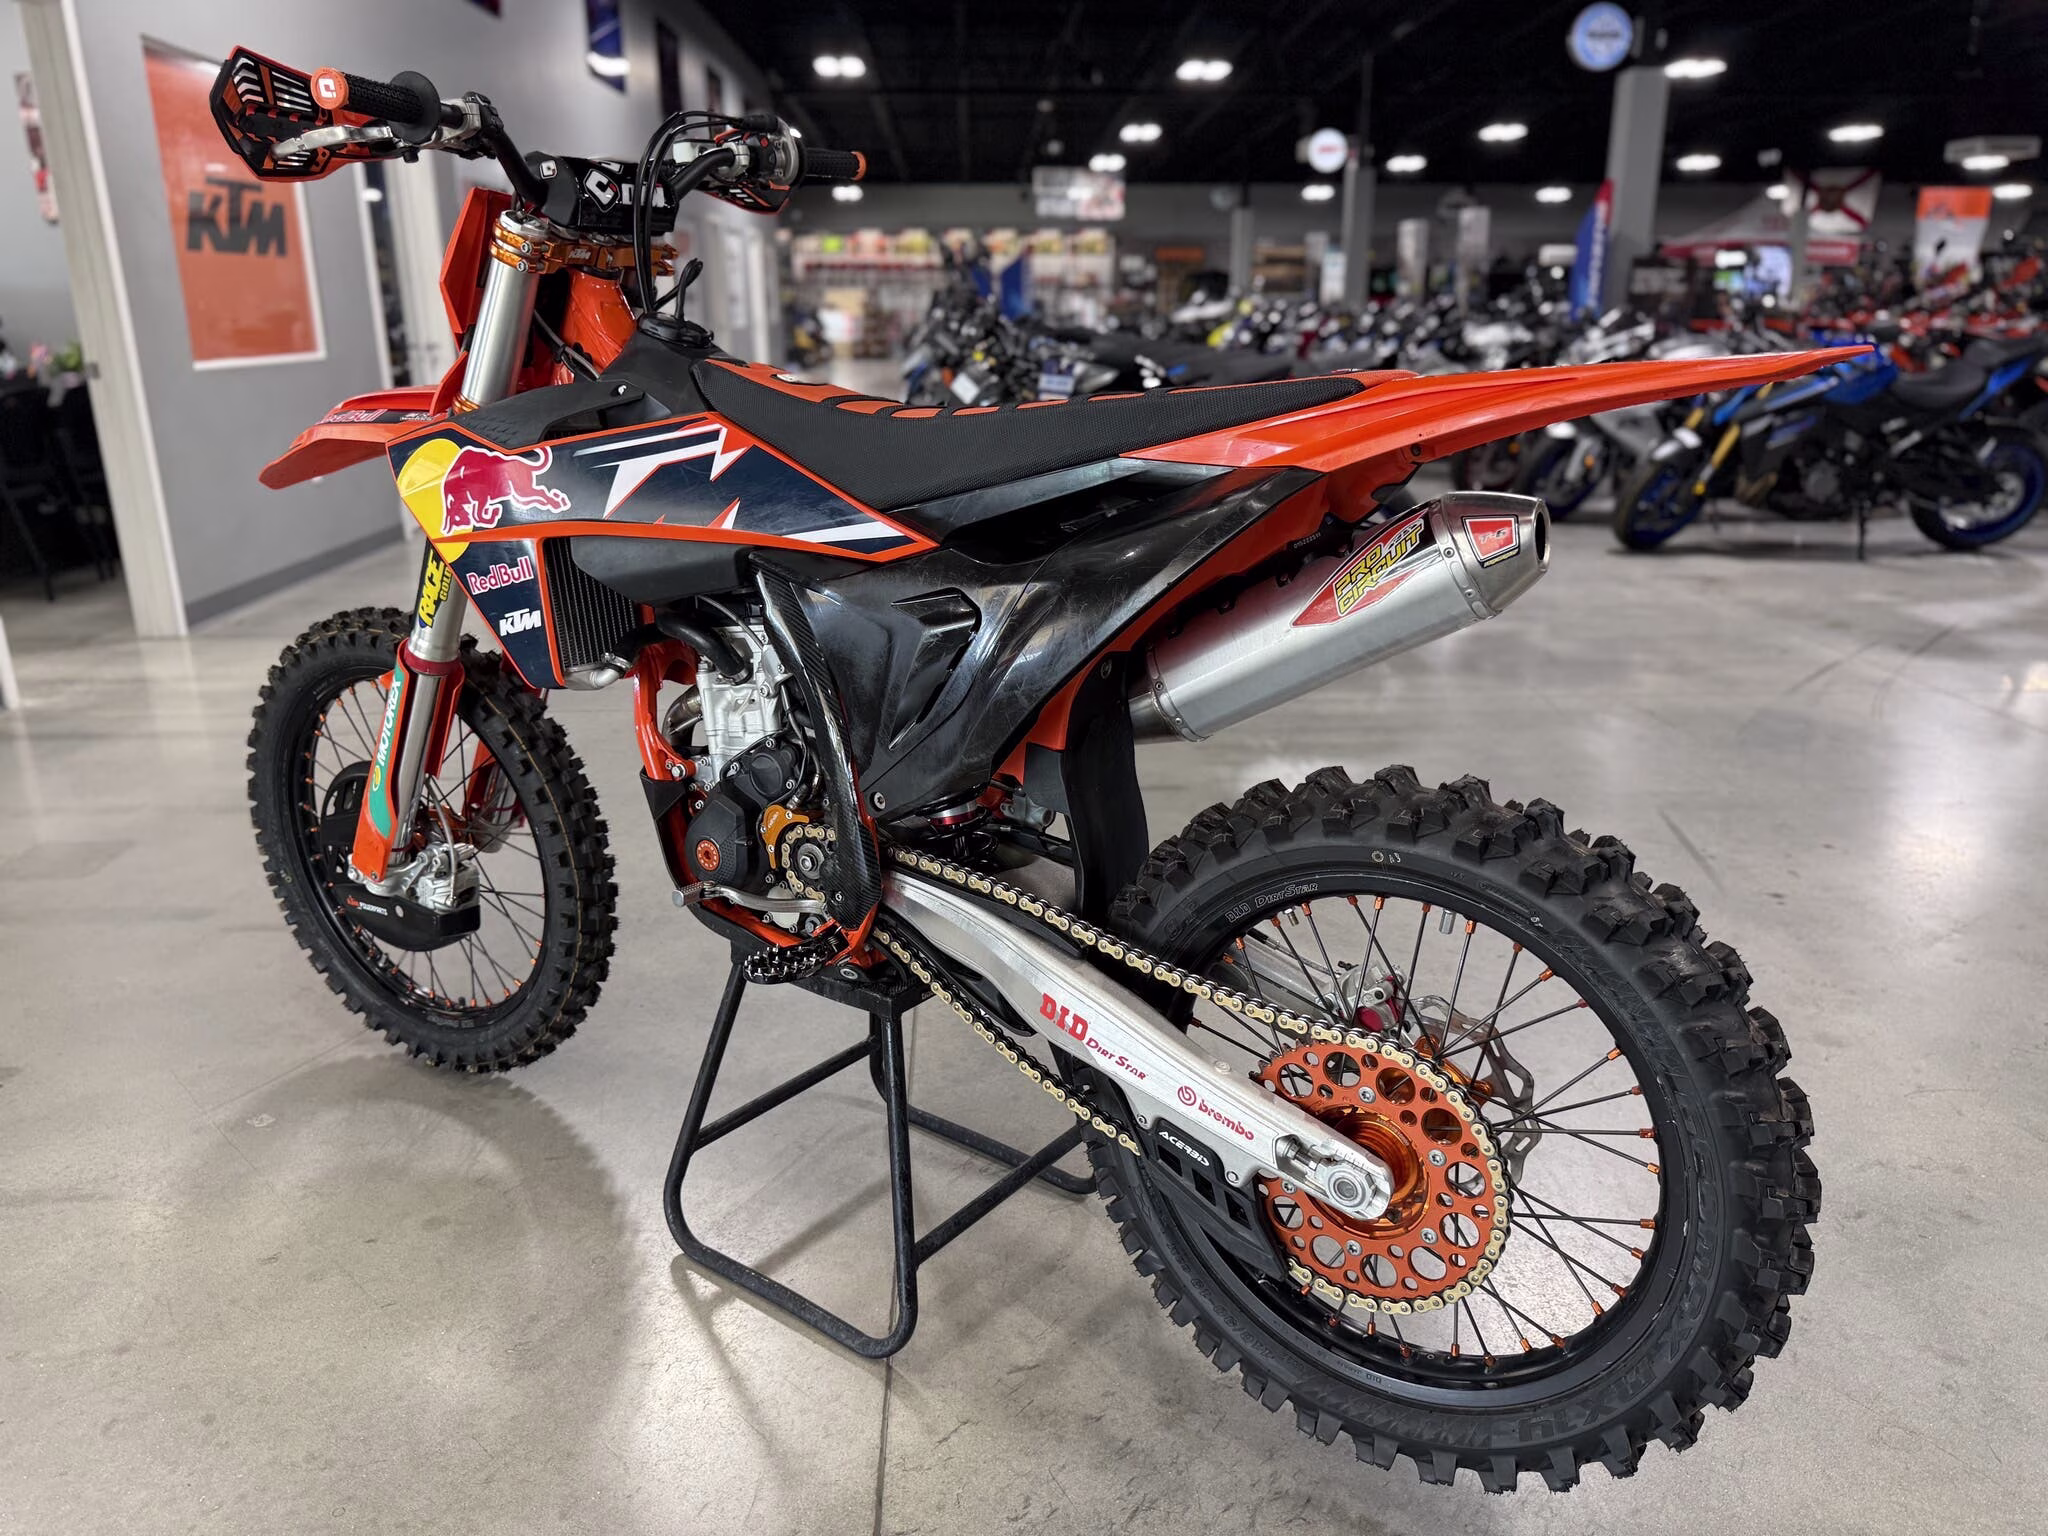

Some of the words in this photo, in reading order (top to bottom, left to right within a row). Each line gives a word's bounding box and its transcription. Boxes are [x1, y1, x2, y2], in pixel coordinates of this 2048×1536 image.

[187, 176, 286, 257] KTM
[418, 549, 445, 628] RACE
[1335, 544, 1383, 597] PRO
[1338, 526, 1424, 615] CIRCUIT
[499, 608, 542, 637] KTM
[376, 681, 401, 767] MOTOREX
[1158, 1130, 1210, 1167] ACERBIS
[1198, 1100, 1254, 1141] brembo
